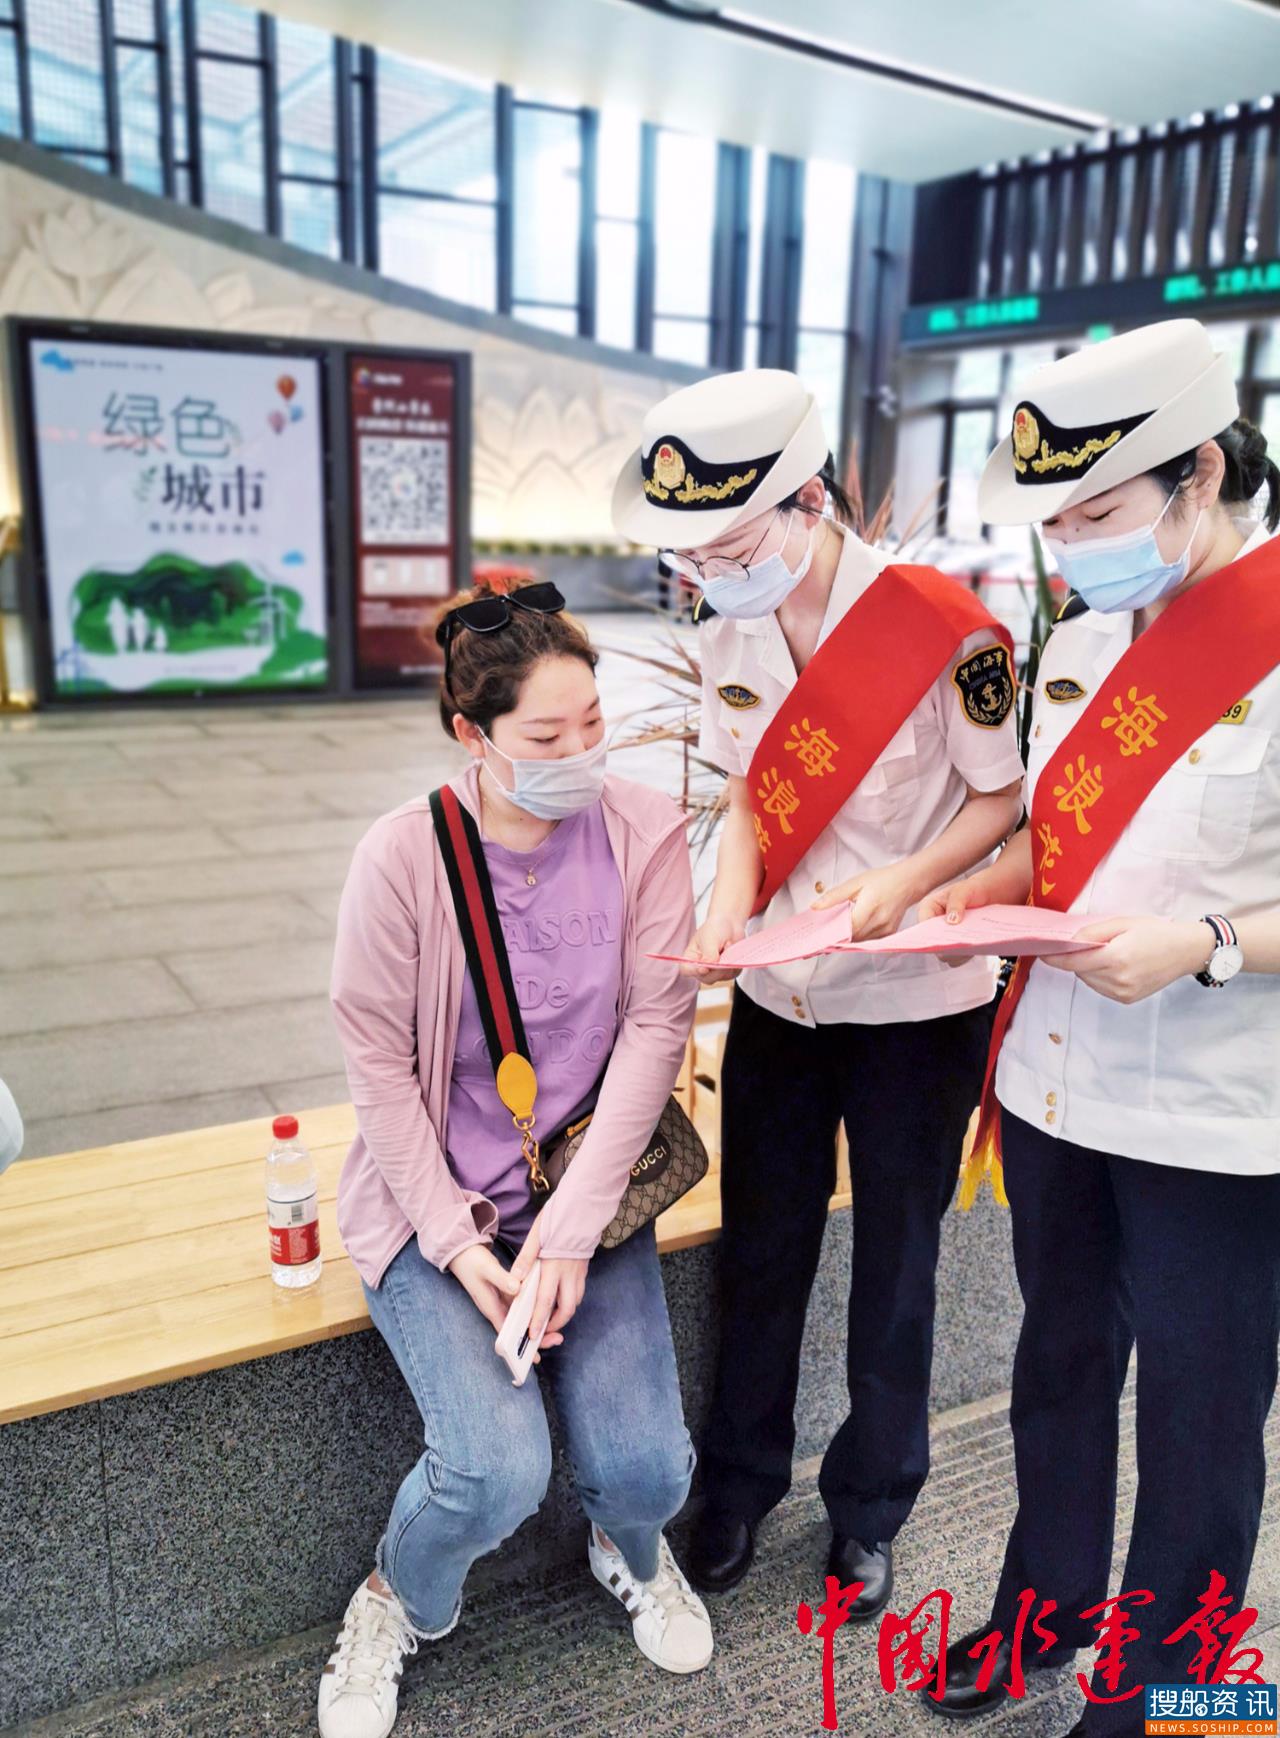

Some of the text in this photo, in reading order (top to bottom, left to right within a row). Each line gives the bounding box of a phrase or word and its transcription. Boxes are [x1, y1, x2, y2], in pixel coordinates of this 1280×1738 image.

[103, 391, 231, 458] 绿色
[162, 464, 266, 517] 城市
[503, 910, 617, 953] AISON
[515, 976, 570, 1010] De
[630, 1145, 667, 1176] GUCCI
